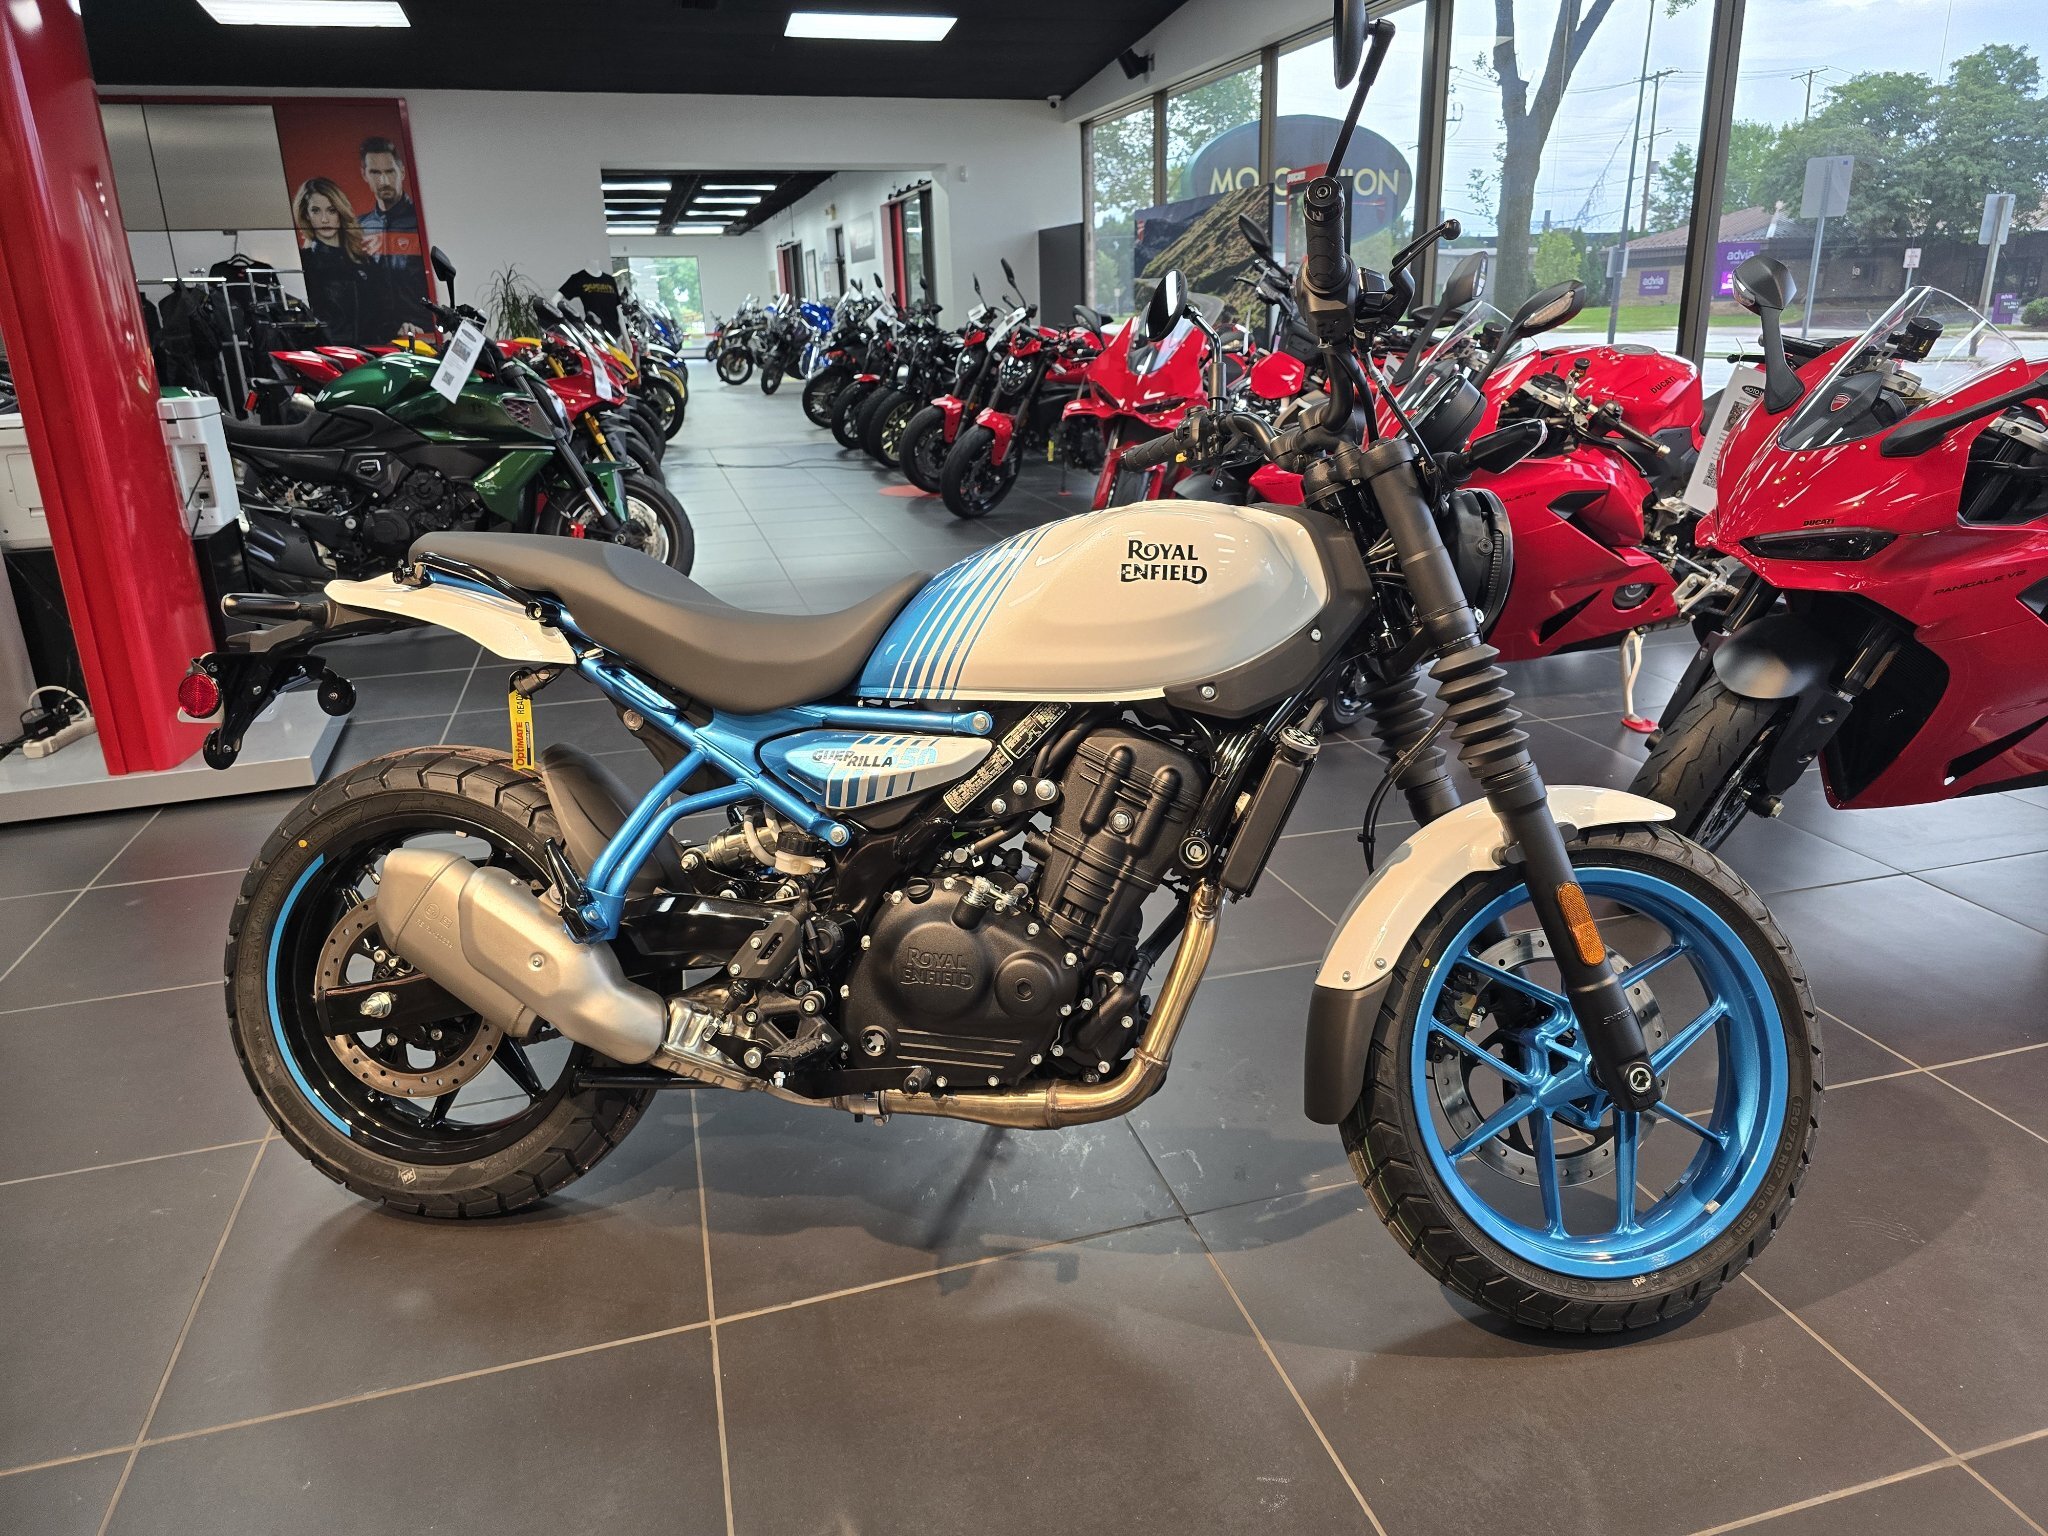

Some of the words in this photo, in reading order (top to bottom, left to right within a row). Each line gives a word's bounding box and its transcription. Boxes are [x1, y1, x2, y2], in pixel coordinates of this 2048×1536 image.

[1210, 167, 1292, 196] MOO
[1727, 250, 1755, 261] advia
[1642, 276, 1664, 286] advia
[1651, 376, 1677, 394] DUCATI
[1803, 518, 1835, 526] DUCATI
[1128, 540, 1199, 561] ROYAL
[1121, 564, 1208, 585] ENFIELD
[1934, 575, 2003, 595] PANIGALE
[515, 722, 525, 766] OptiMATE
[812, 750, 893, 768] GUERRILLA
[907, 947, 967, 969] ROYAL
[900, 967, 975, 990] ENFIELD
[1782, 1100, 1803, 1152] 120/70
[1773, 1153, 1790, 1179] R17
[1755, 1182, 1777, 1211] M/C
[1552, 1277, 1589, 1293] CEAT
